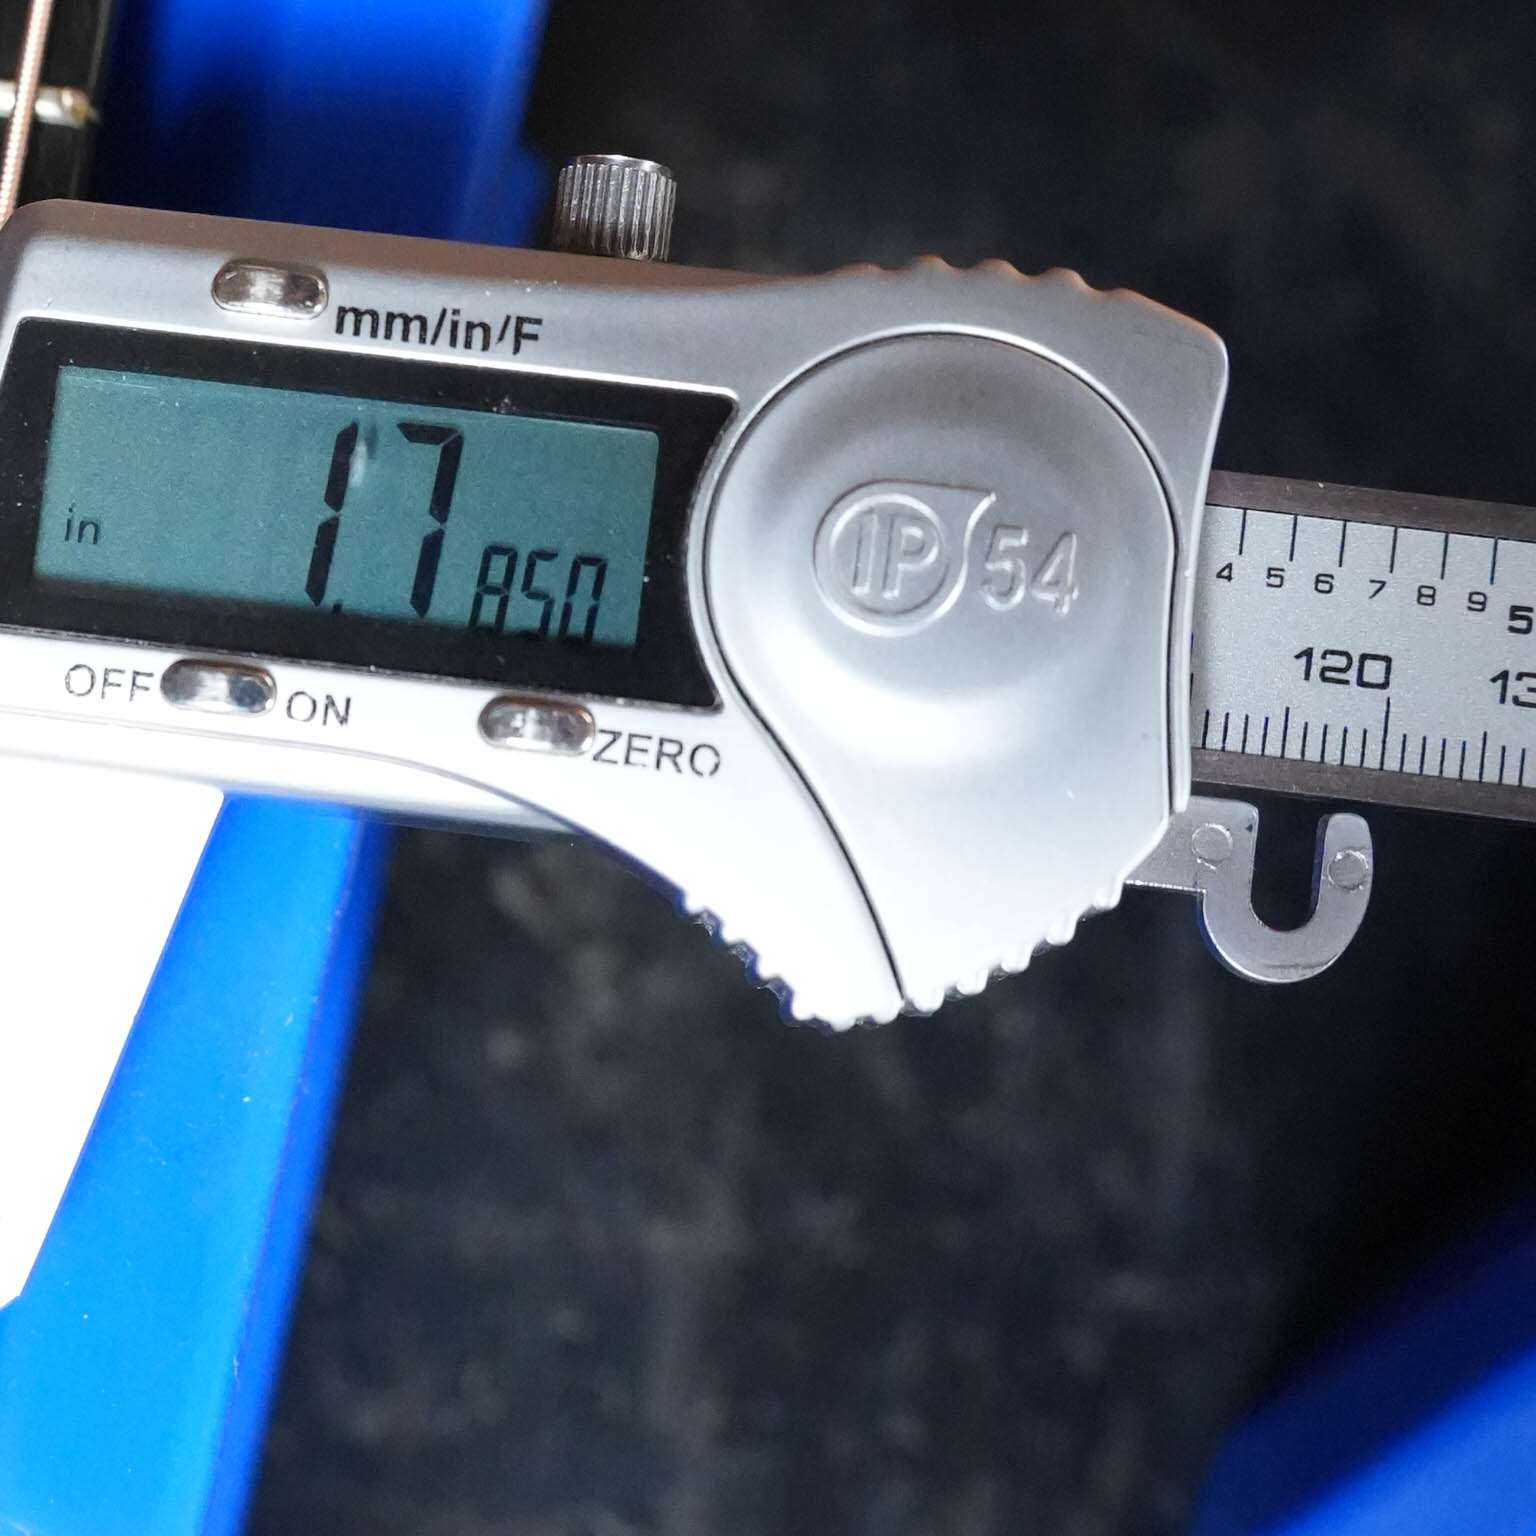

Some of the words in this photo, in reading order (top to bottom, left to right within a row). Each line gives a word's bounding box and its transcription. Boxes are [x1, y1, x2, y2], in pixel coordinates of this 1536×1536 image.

[335, 304, 543, 356] mm/in/F
[64, 507, 100, 545] in
[850, 507, 940, 601] IP
[980, 523, 1080, 616] 54
[1215, 561, 1235, 584] 4
[1265, 566, 1286, 589] 5
[1313, 572, 1336, 595] 6
[1368, 578, 1388, 600] 7
[1415, 584, 1438, 607] 8
[1465, 590, 1489, 613] 9
[1506, 604, 1535, 636] 5
[64, 663, 156, 702] OFF
[1293, 646, 1393, 691] 120
[285, 680, 352, 727] ON
[592, 728, 722, 778] ZERO
